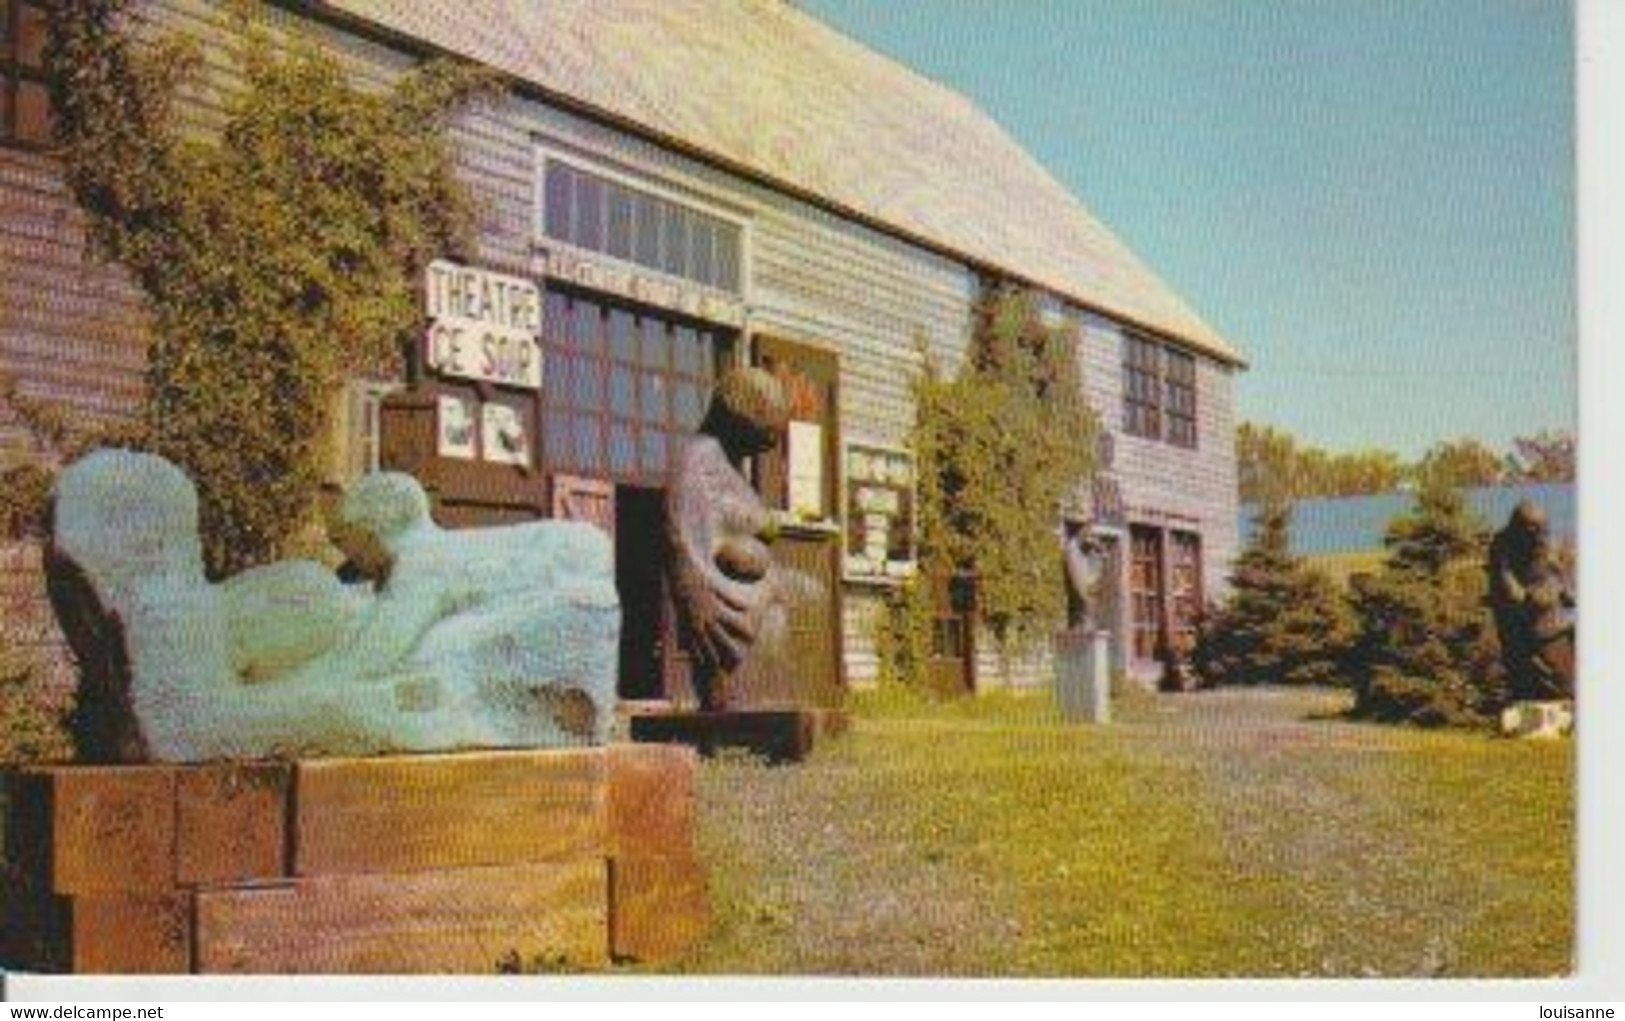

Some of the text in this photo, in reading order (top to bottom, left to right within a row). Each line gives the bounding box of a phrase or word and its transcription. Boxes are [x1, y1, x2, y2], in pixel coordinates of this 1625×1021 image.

[432, 265, 539, 331] THEATRE
[434, 324, 533, 383] CE SOIR
